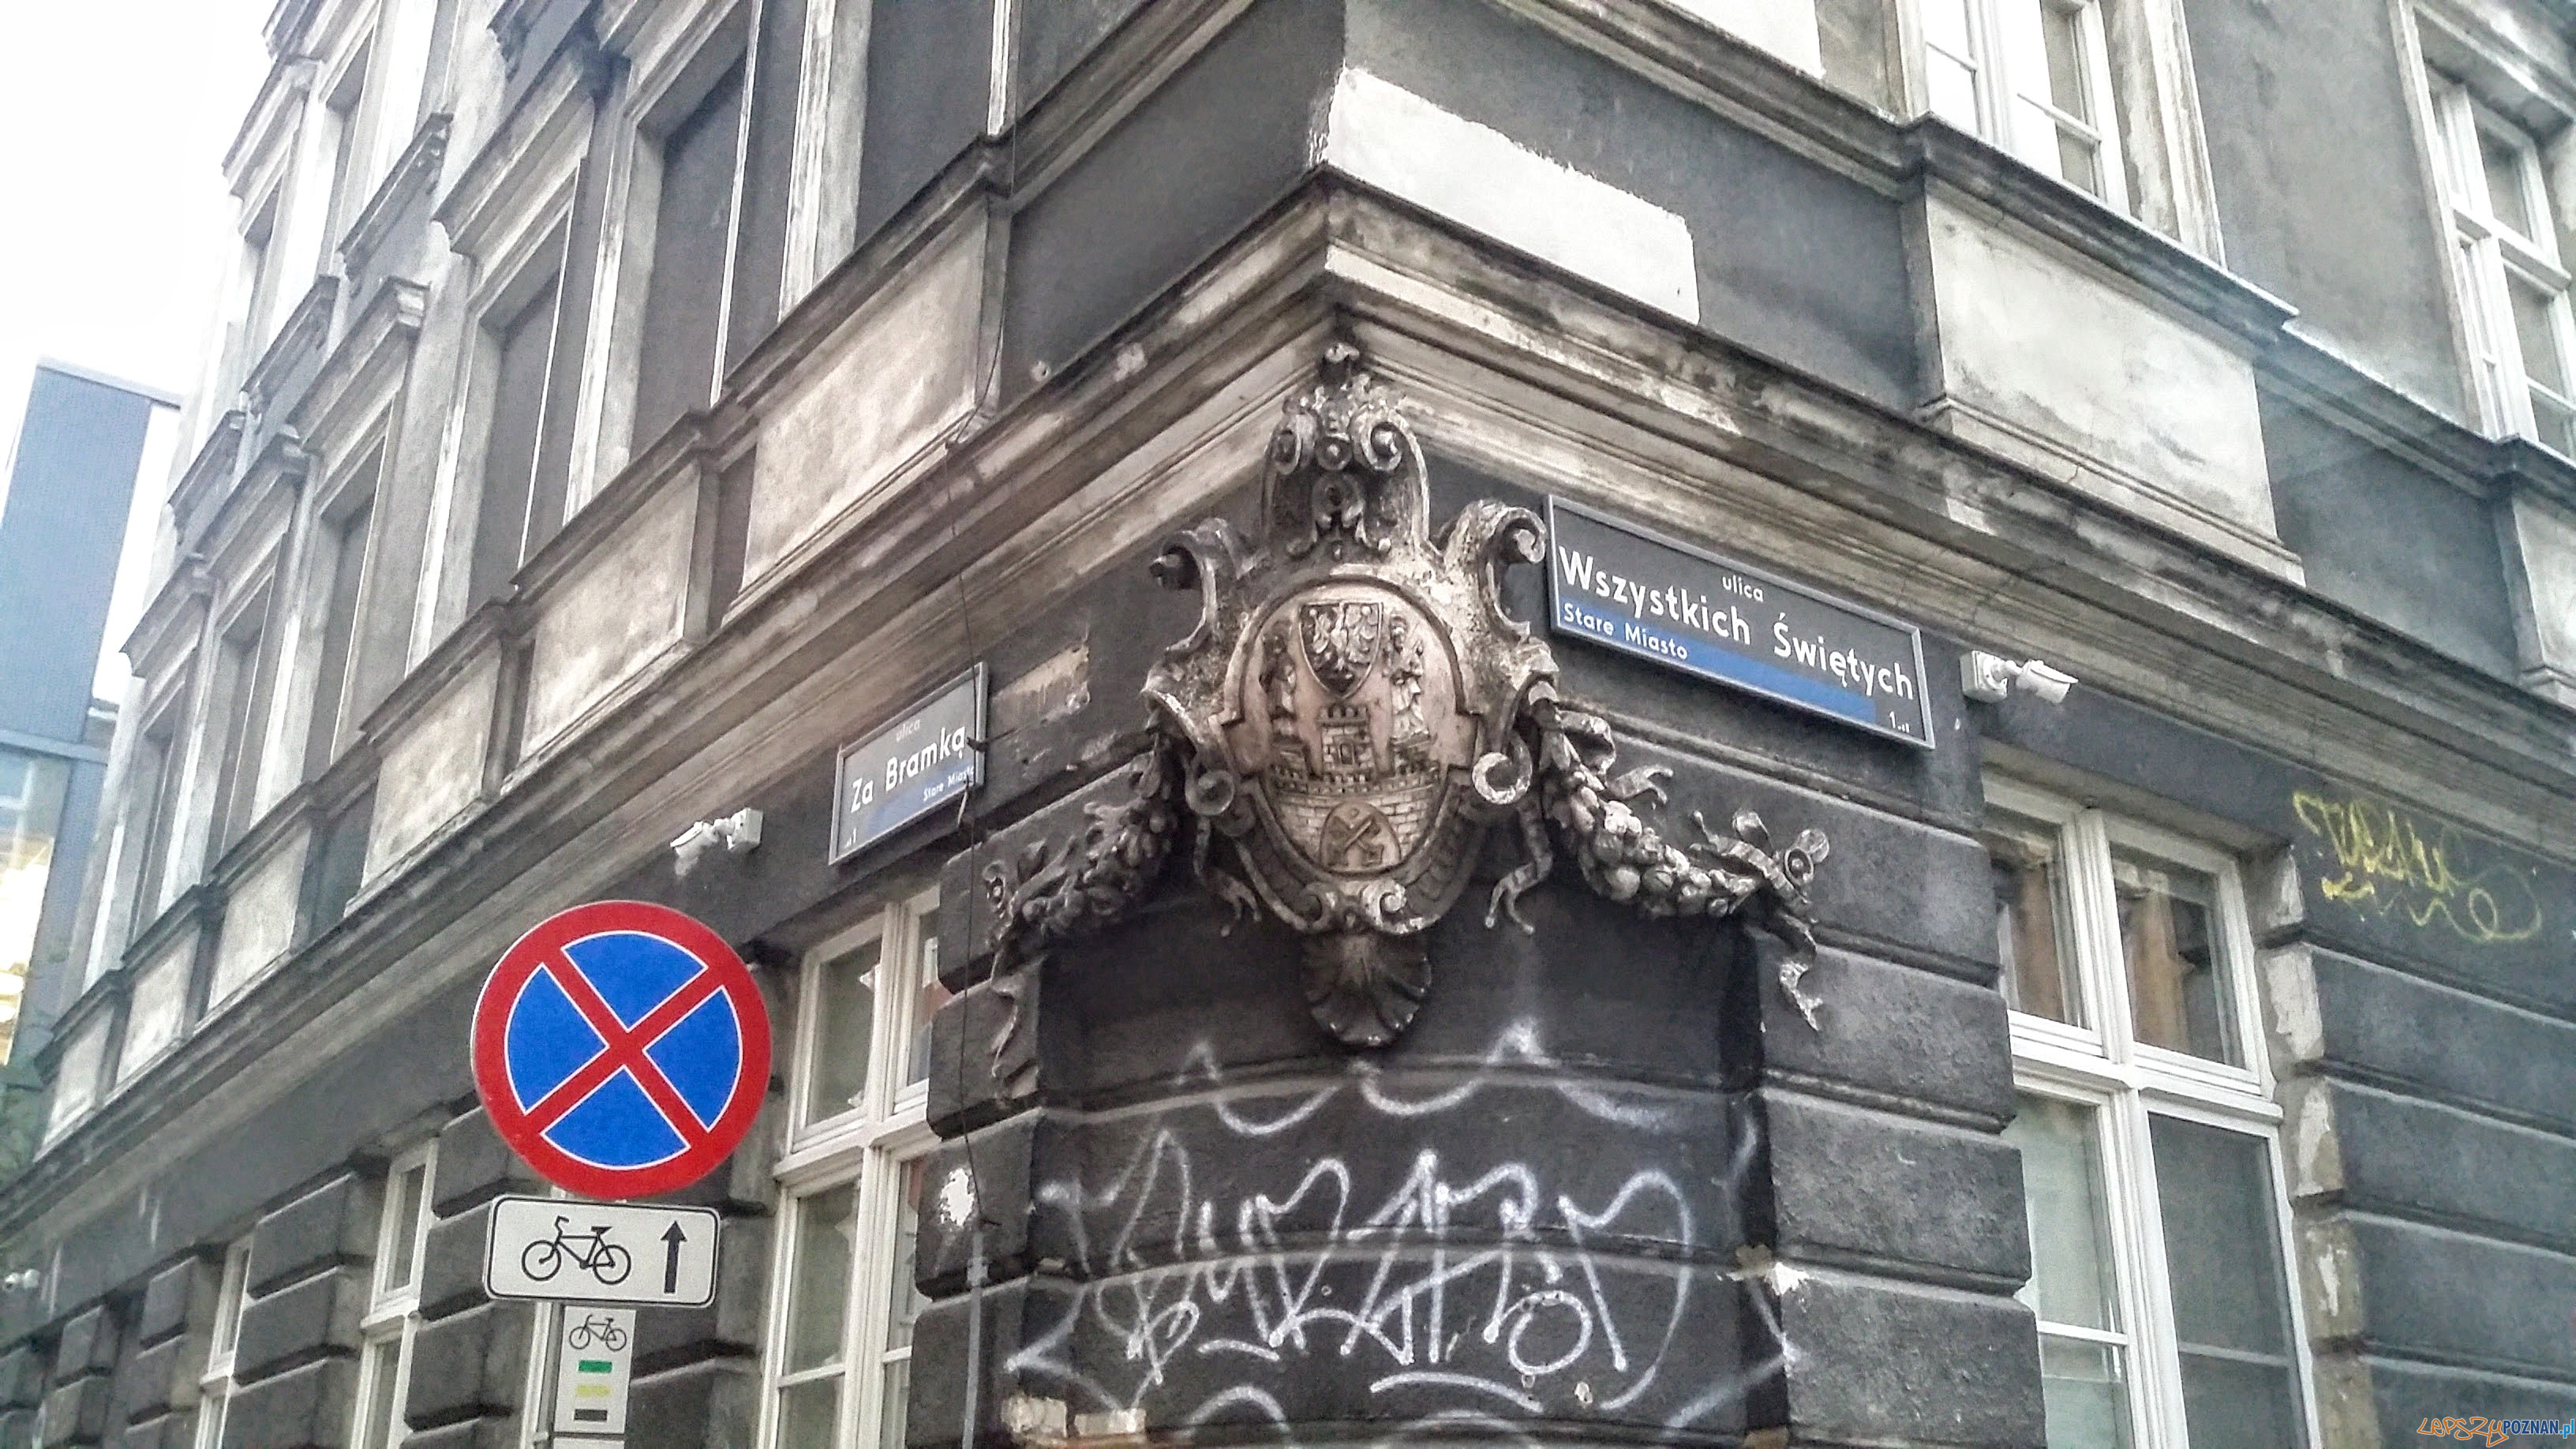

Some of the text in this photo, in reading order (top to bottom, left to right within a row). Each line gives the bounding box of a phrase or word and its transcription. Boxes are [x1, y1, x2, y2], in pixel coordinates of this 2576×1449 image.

[1721, 575, 1764, 603] ulica
[1559, 545, 1914, 700] Wszystkich Świętych
[1563, 603, 1688, 661] Stare Miasto
[850, 726, 965, 814] Za Bramką
[923, 783, 944, 802] Stare
